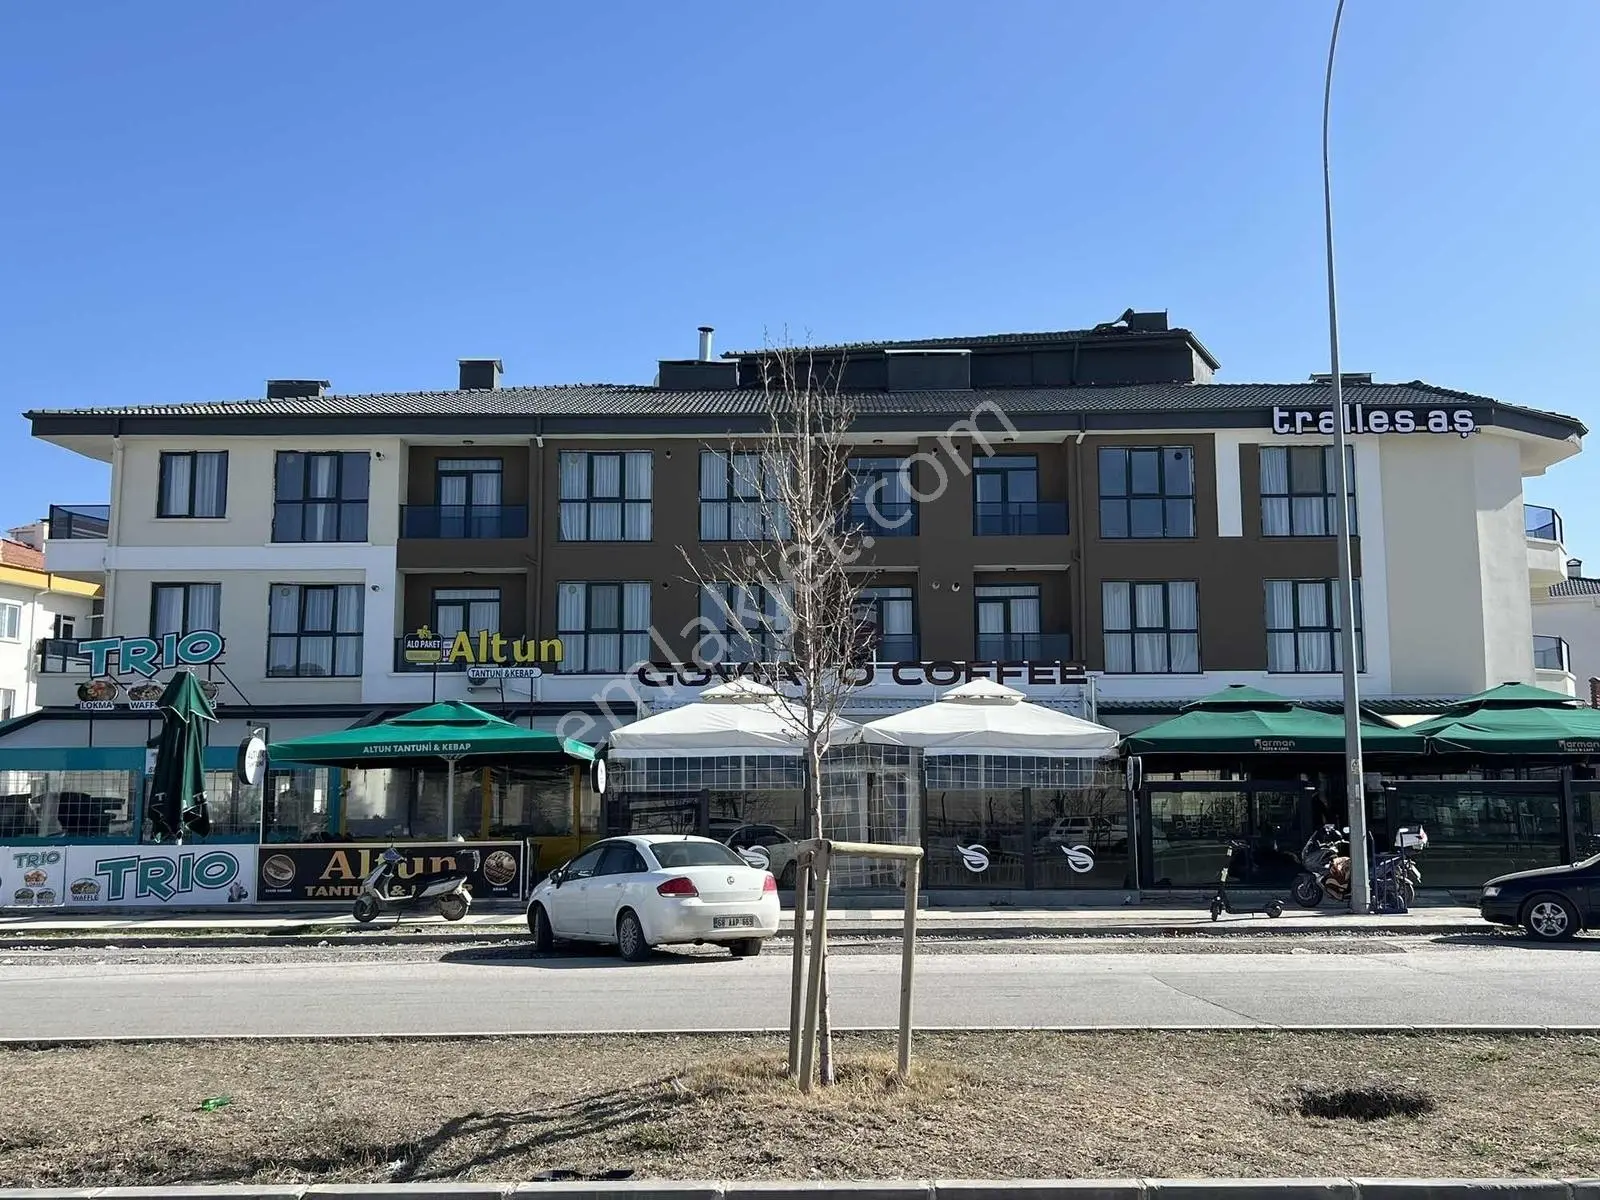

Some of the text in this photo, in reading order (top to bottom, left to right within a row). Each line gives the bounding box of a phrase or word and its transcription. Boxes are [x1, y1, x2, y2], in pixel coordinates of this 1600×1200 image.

[1273, 403, 1475, 438] tralles aş
[78, 630, 224, 677] TRIO
[406, 640, 440, 648] ALO PAKET
[449, 629, 564, 664] Altun
[510, 669, 534, 678] KEBAP
[638, 661, 1089, 687] GOVIAO COFFEE
[442, 743, 471, 751] KEBAP
[95, 851, 239, 901] TRIO
